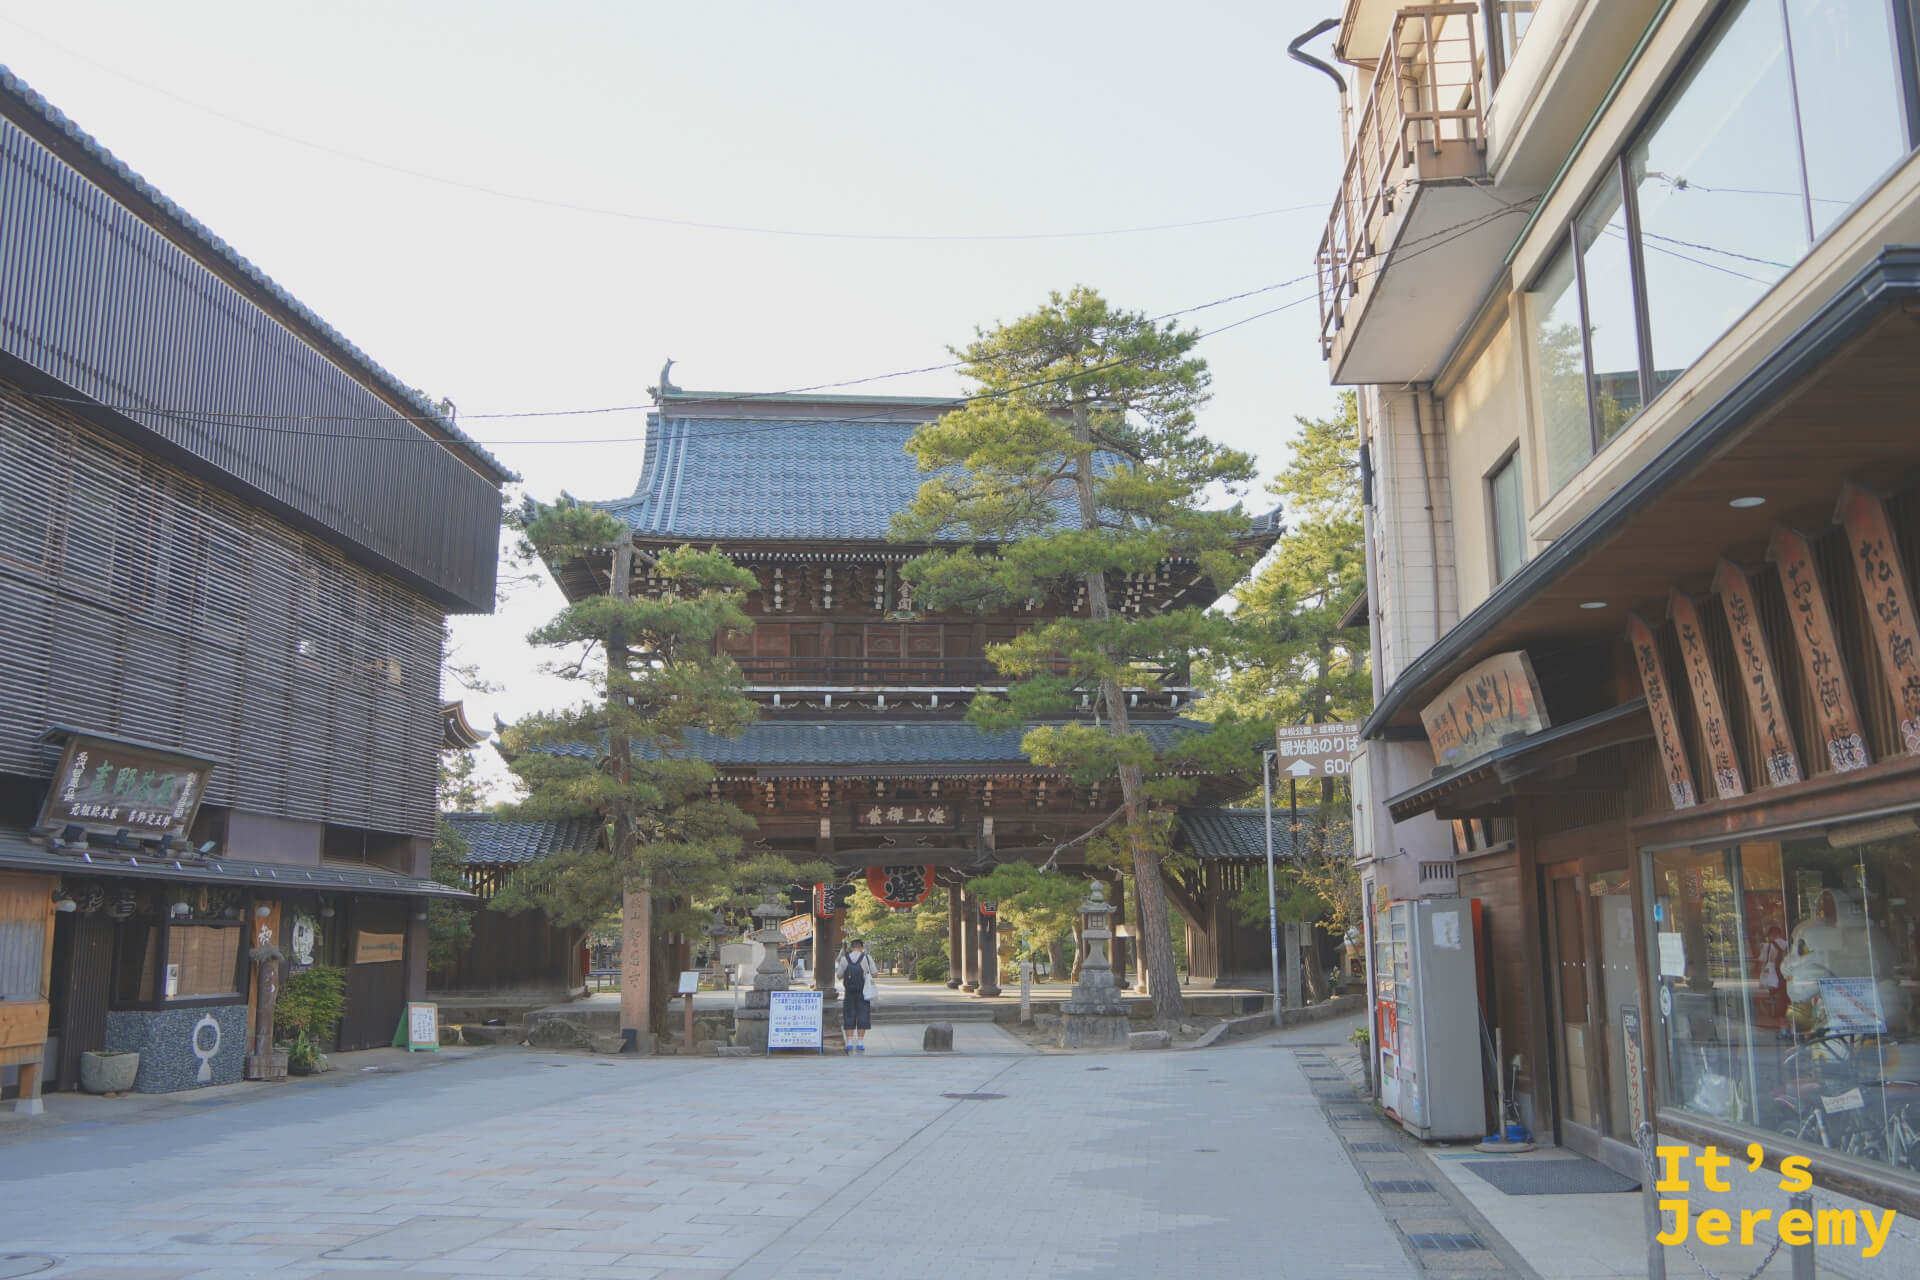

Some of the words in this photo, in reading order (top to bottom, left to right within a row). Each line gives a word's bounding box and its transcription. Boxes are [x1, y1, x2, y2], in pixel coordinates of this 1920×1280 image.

[1280, 736, 1359, 757] 観光船のりば
[91, 760, 177, 806] 吉野茶屋
